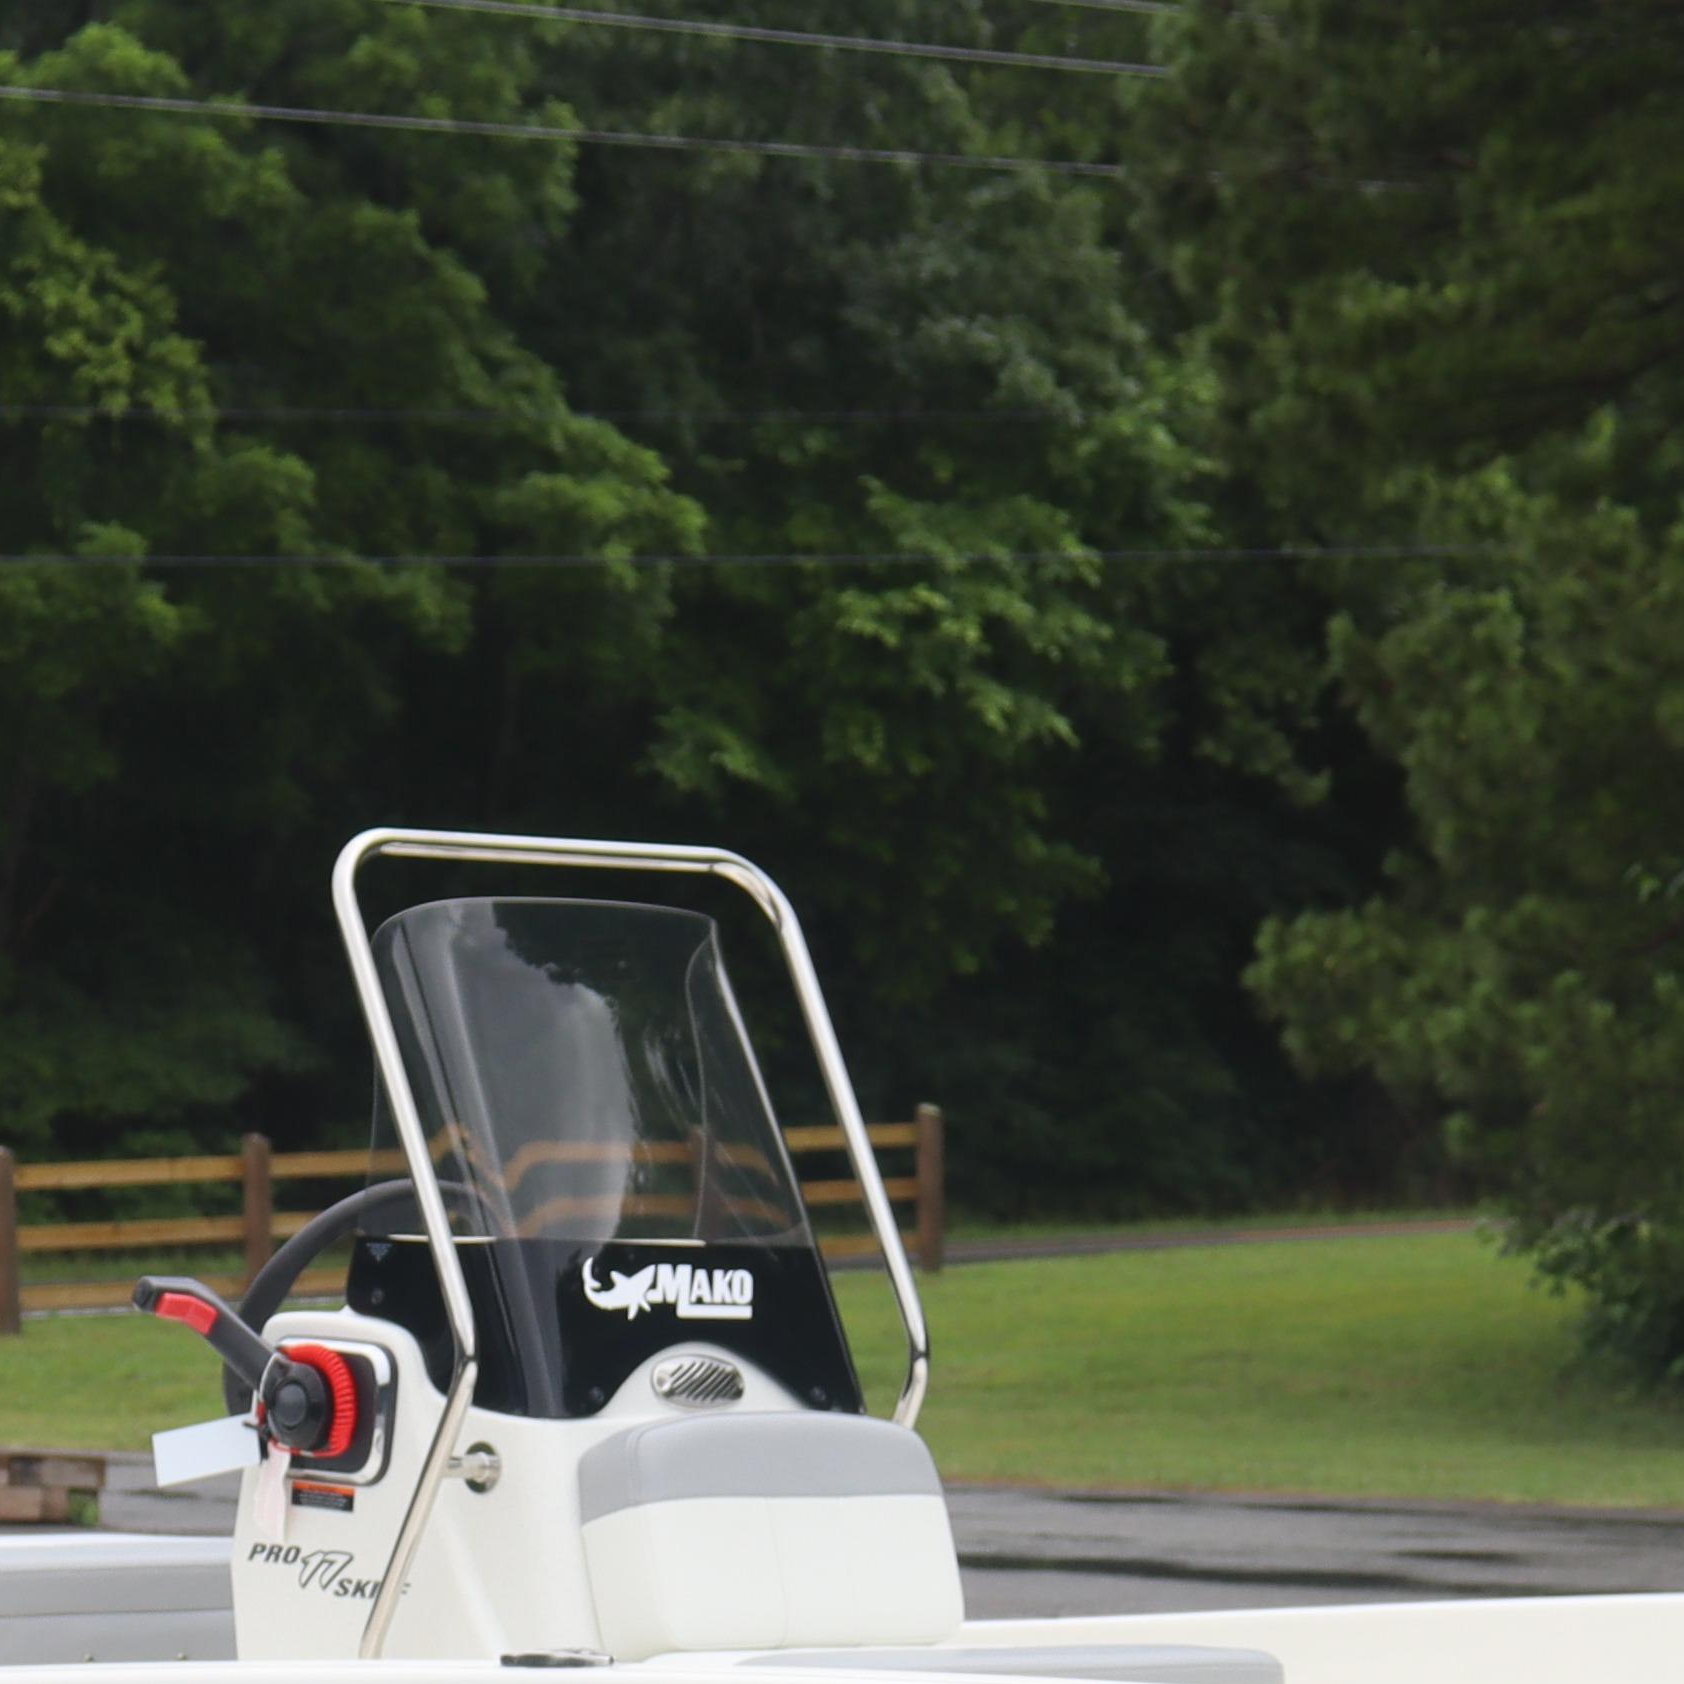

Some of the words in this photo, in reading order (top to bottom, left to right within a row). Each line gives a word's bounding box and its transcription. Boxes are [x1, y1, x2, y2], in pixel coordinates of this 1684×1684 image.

[645, 1263, 754, 1319] MAKO
[248, 1543, 302, 1564] PRO
[298, 1550, 354, 1591] 17
